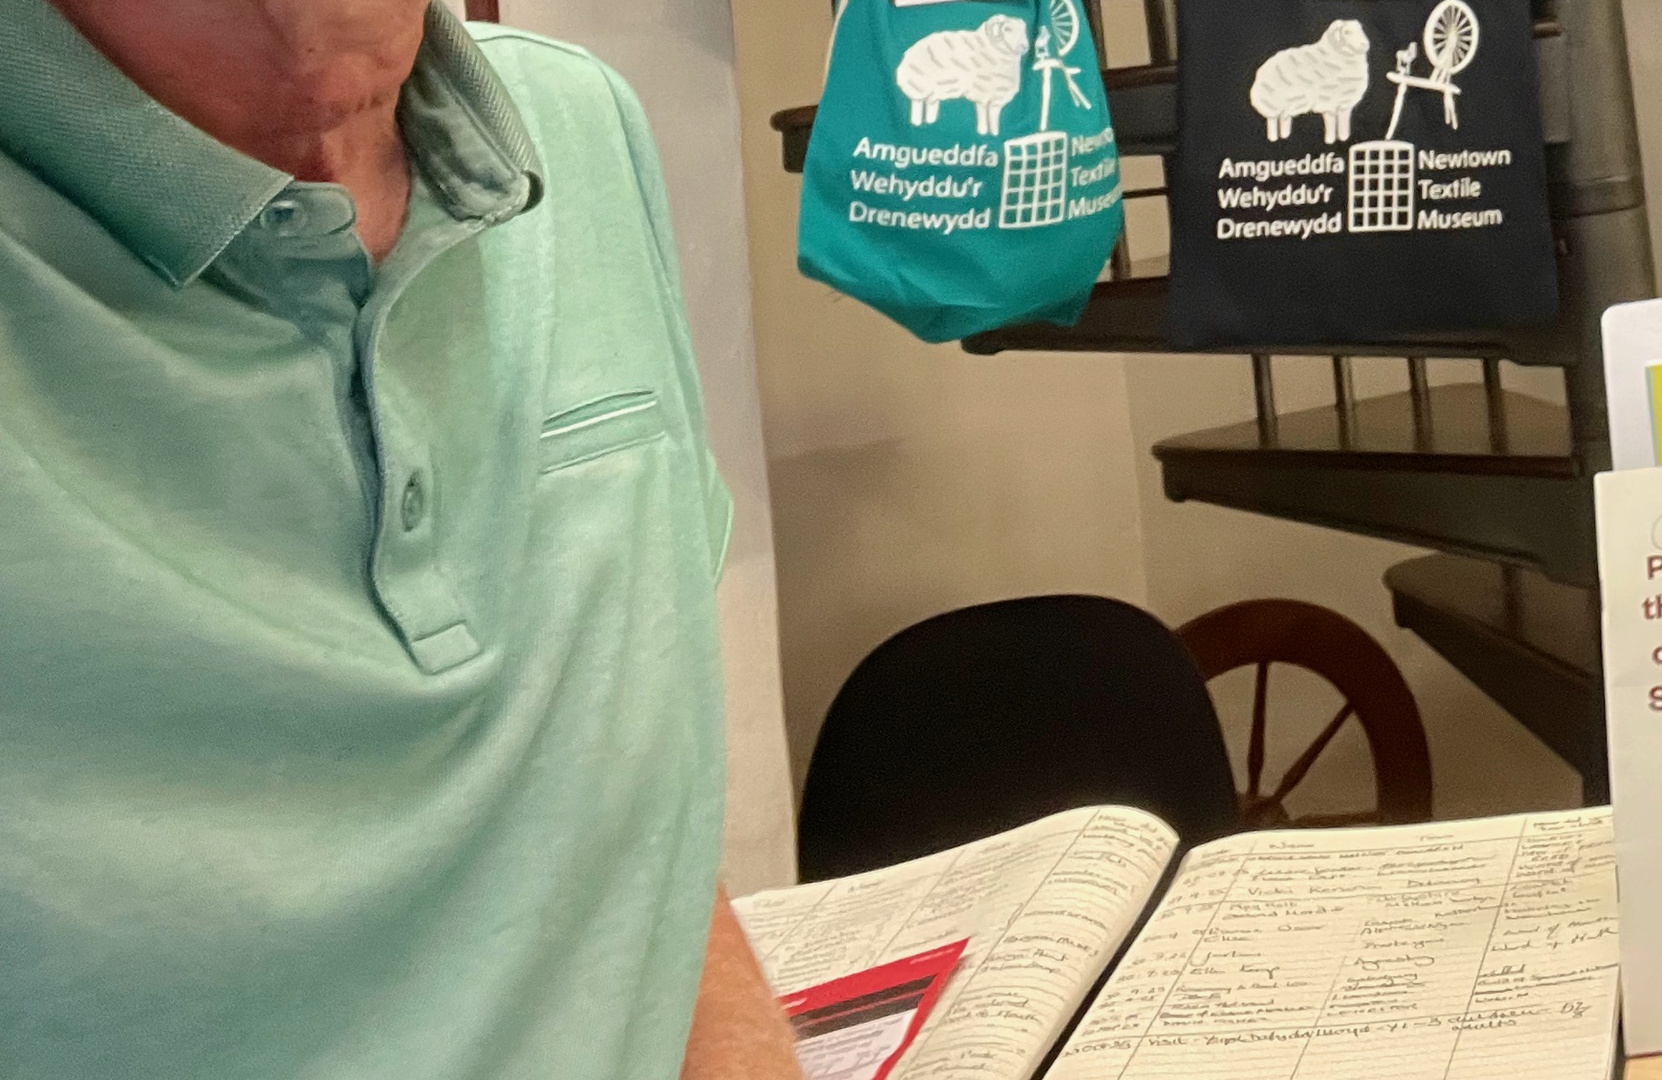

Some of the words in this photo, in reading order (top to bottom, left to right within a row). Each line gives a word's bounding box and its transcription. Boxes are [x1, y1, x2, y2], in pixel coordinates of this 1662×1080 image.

[853, 136, 999, 168] Amgueddfa
[1218, 151, 1345, 182] Amgueddfa
[1418, 149, 1512, 170] Newtown
[850, 170, 983, 201] Wehyddu'r
[1217, 183, 1334, 212] Wehyddu'r
[1417, 176, 1481, 200] Textile
[849, 200, 991, 235] Drenewydd
[1217, 211, 1342, 240] Drenewydd
[1417, 209, 1503, 230] Museum
